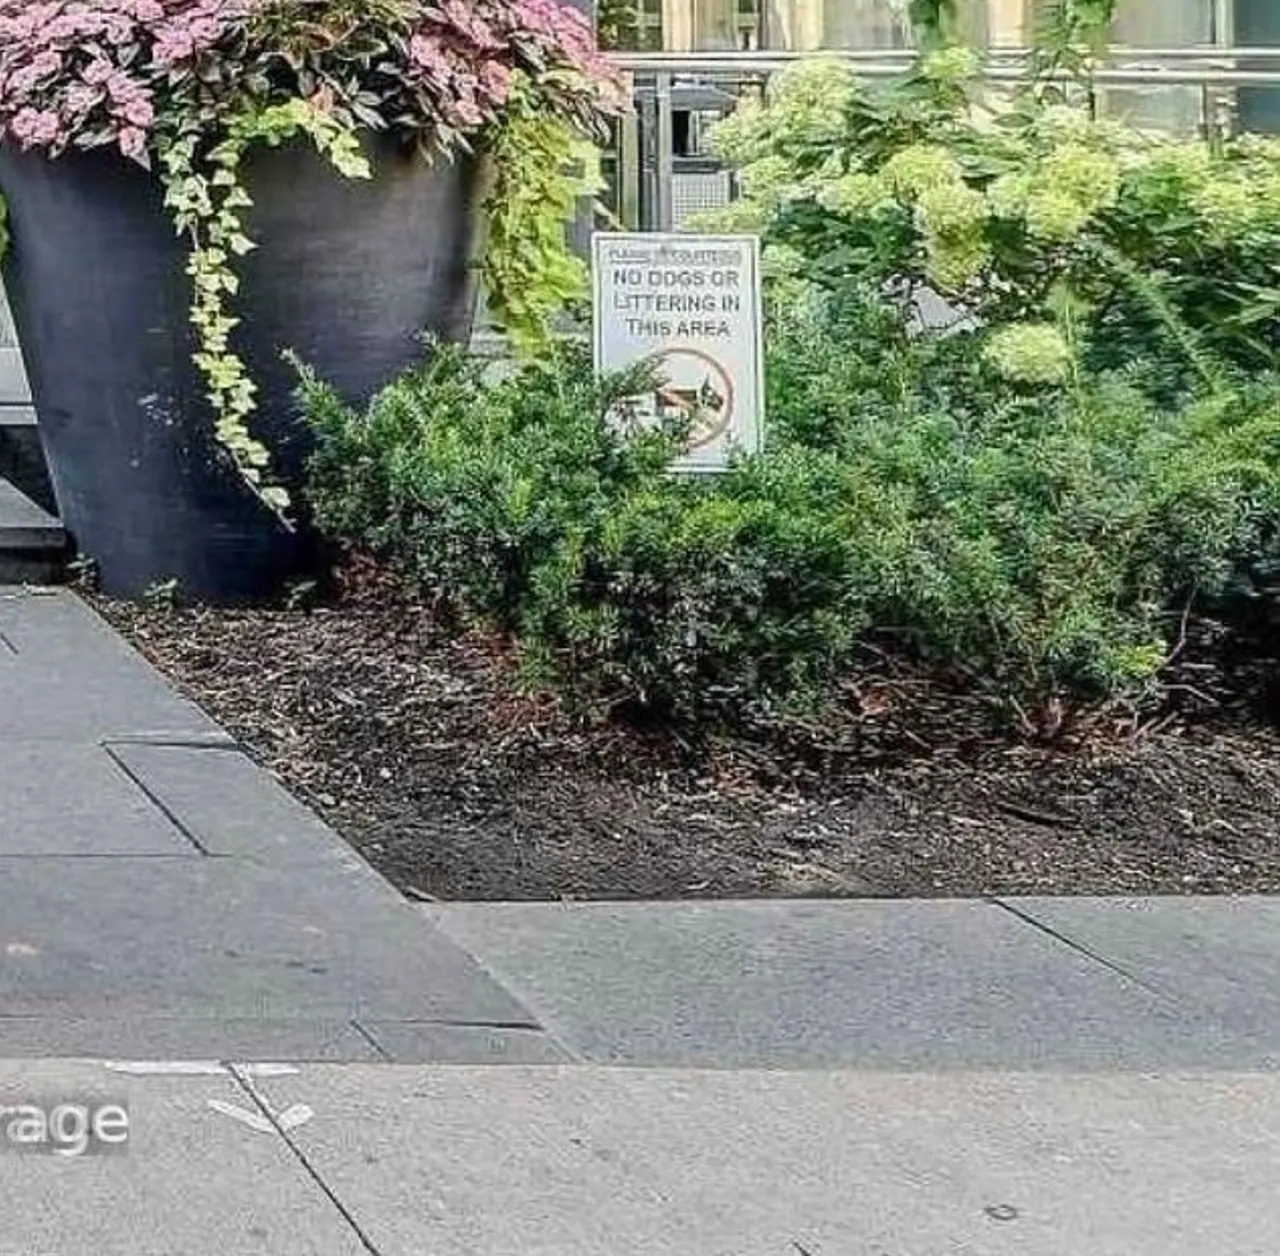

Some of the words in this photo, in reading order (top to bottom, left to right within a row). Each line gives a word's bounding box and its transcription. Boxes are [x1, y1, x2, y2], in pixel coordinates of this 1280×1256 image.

[613, 270, 642, 286] NO
[648, 270, 705, 287] DOGS
[711, 270, 740, 287] OR
[613, 295, 716, 312] LITTERING
[722, 295, 741, 312] IN
[626, 318, 672, 337] THIS
[677, 318, 731, 337] AREA
